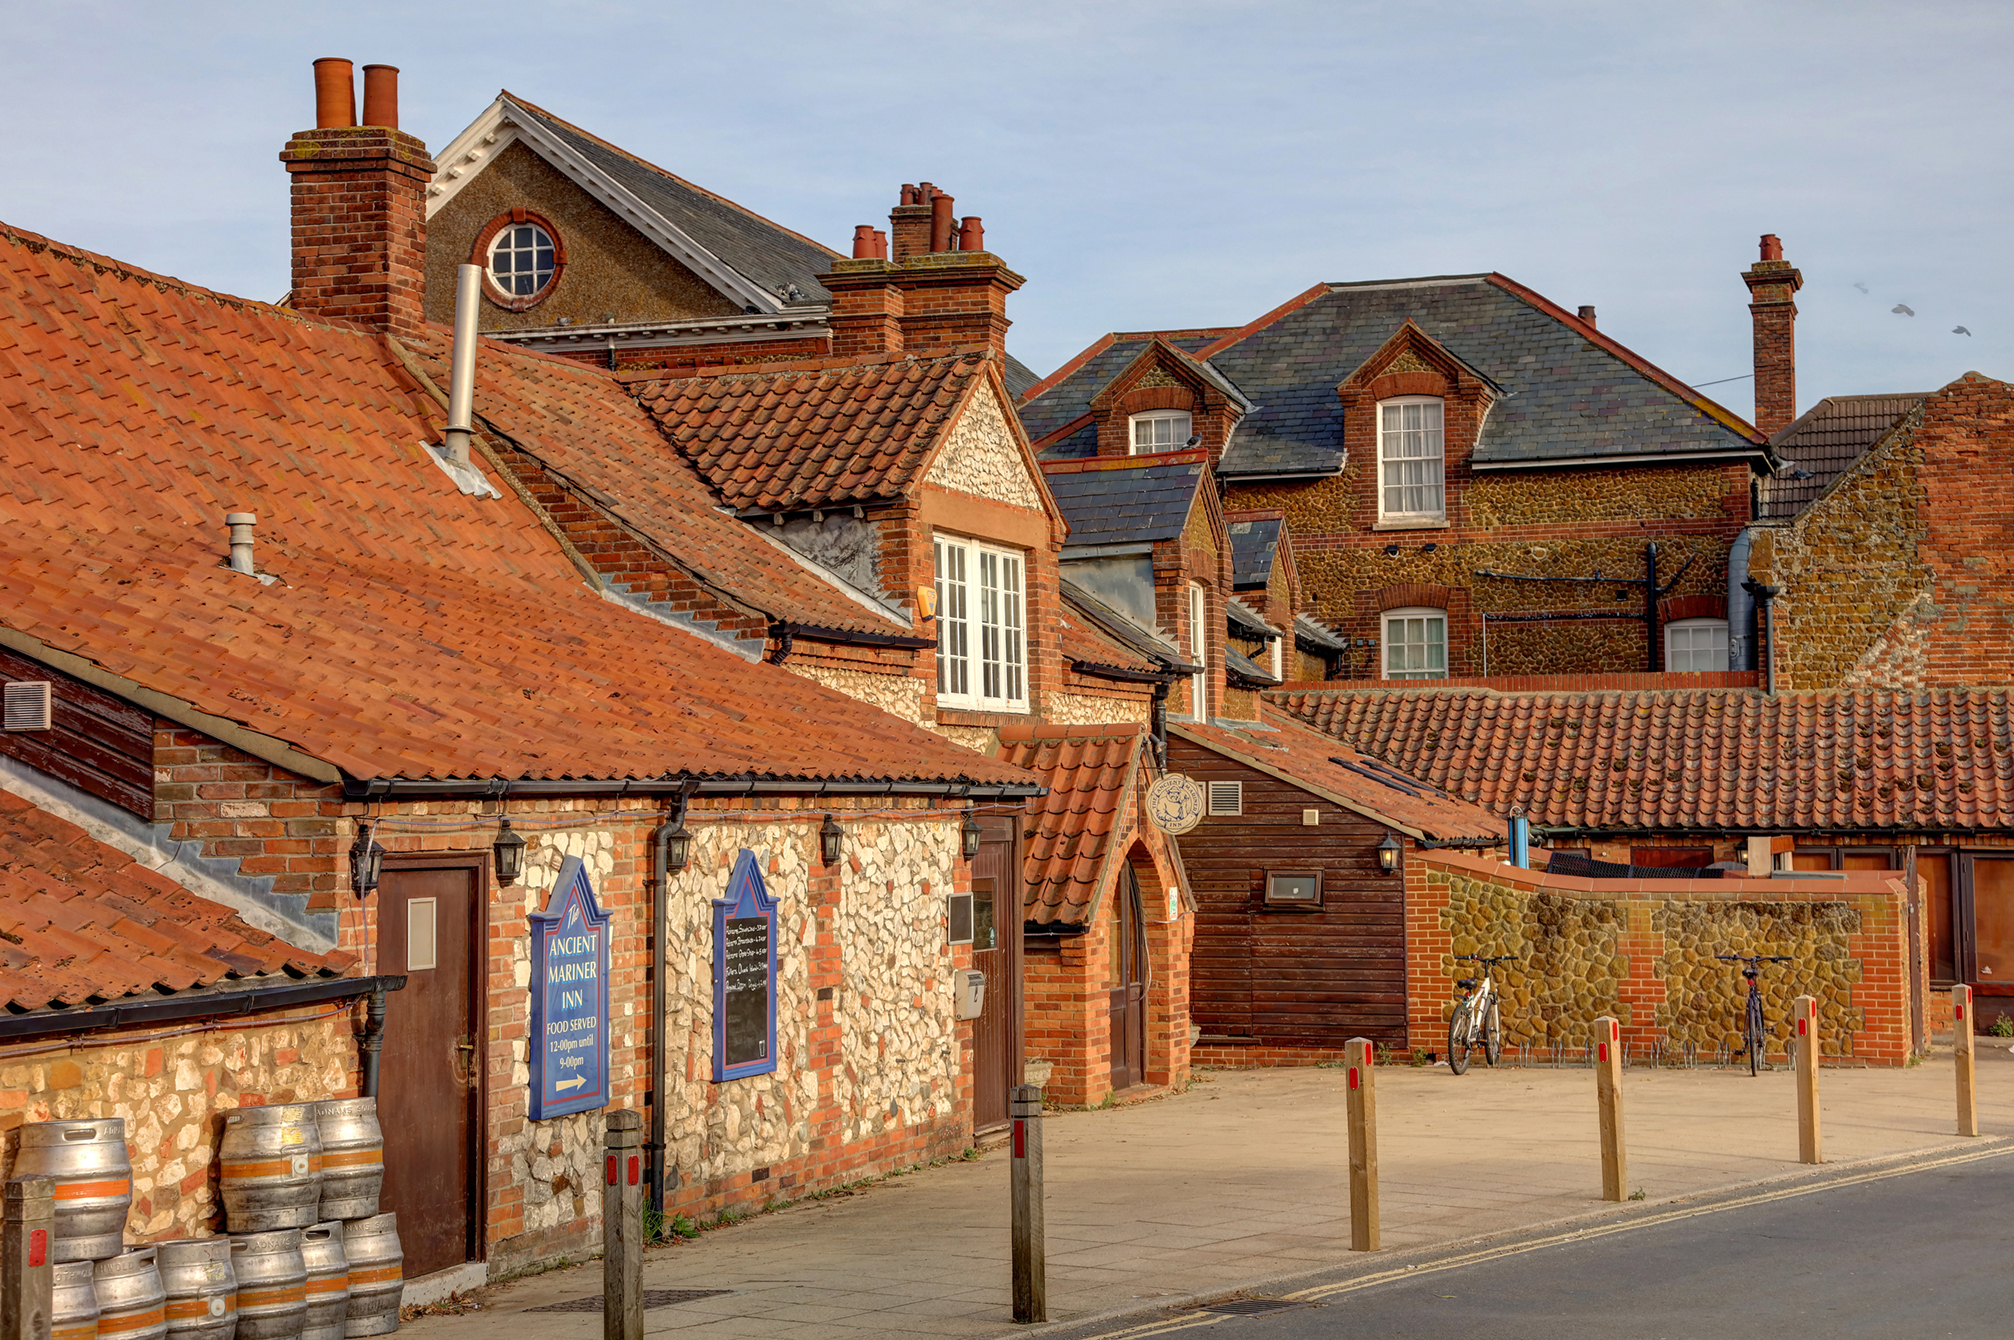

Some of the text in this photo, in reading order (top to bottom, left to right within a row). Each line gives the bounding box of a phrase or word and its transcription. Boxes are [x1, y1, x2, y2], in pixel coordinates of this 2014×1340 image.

[1157, 780, 1182, 793] ANCIENT
[1185, 784, 1198, 812] MARINER
[568, 903, 580, 930] The
[549, 934, 597, 957] ANCIENT
[548, 961, 597, 984] MARINER
[562, 989, 583, 1009] INN
[546, 1016, 597, 1035] FOOD SERVED
[579, 1033, 594, 1048] until
[316, 1105, 353, 1117] ADNAMS
